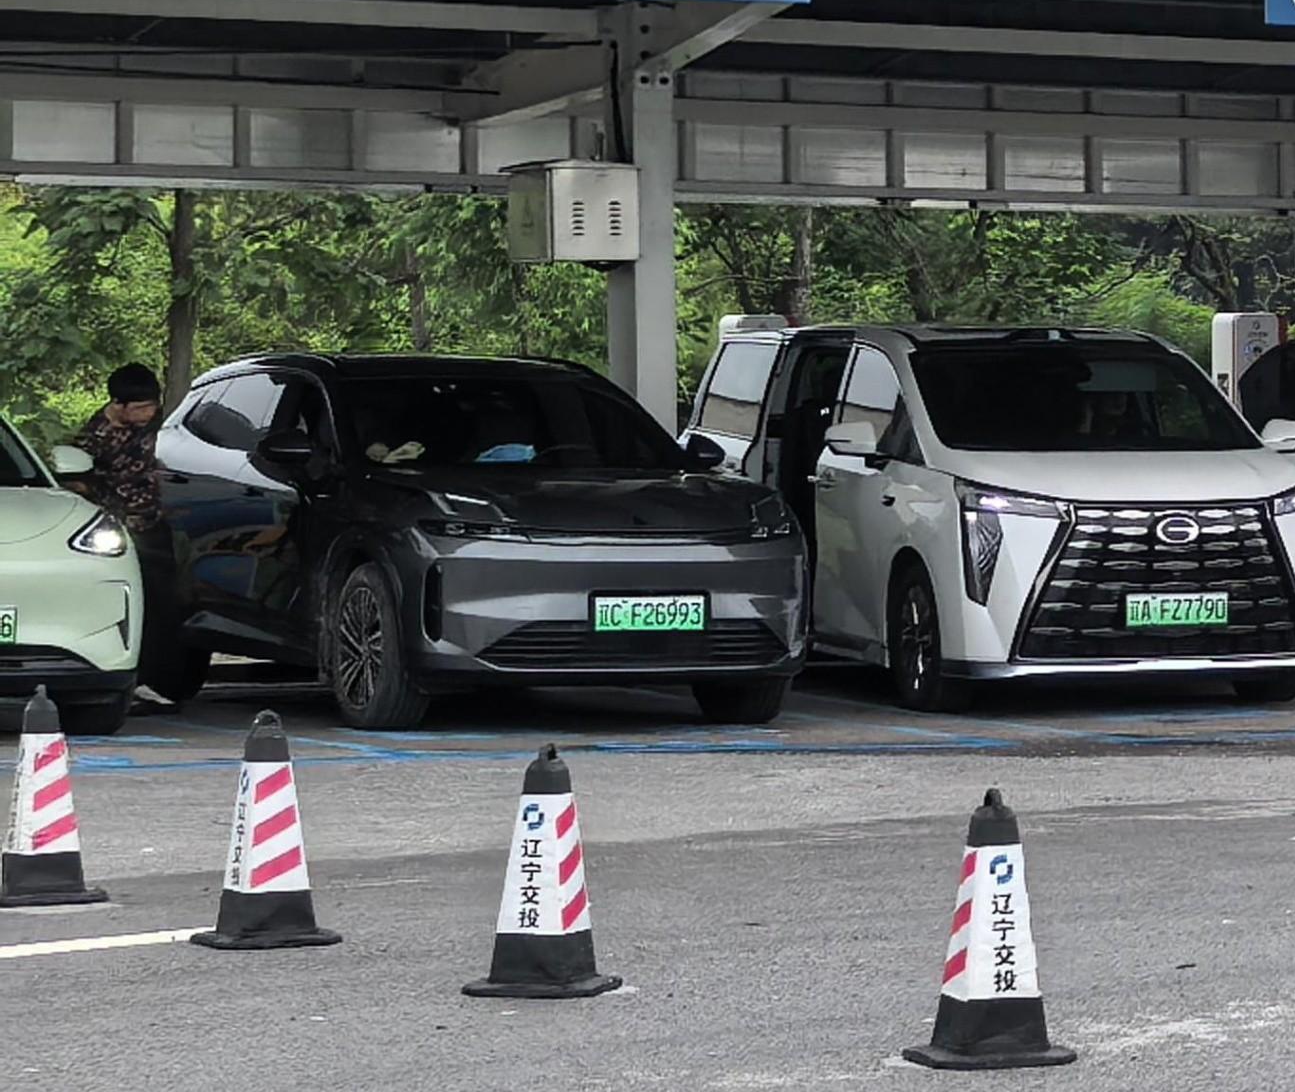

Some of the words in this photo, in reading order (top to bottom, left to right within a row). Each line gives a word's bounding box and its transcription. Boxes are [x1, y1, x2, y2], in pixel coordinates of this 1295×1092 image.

[518, 838, 542, 929] 辽宁交投
[991, 893, 1018, 992] 辽宁交投
